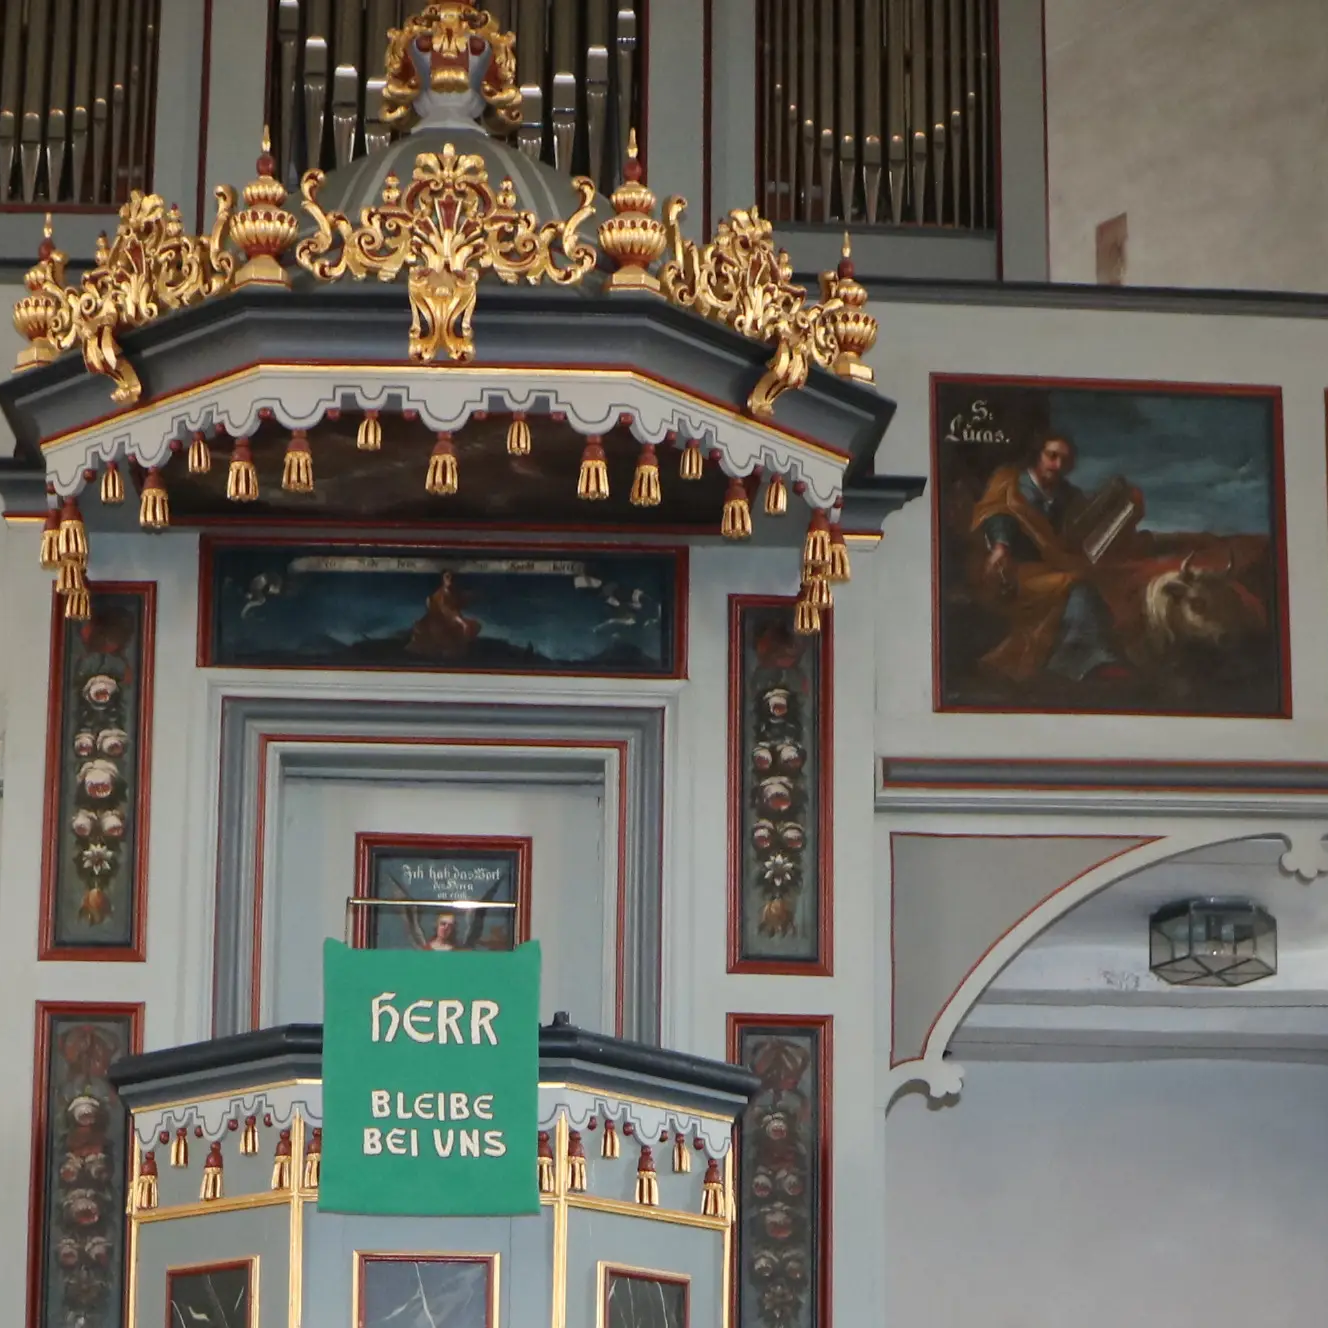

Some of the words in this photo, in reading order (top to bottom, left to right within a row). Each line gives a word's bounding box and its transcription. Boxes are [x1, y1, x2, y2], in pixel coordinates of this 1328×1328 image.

[371, 992, 500, 1046] HERR
[371, 1089, 494, 1121] BLEIBE
[363, 1127, 419, 1157] BEI
